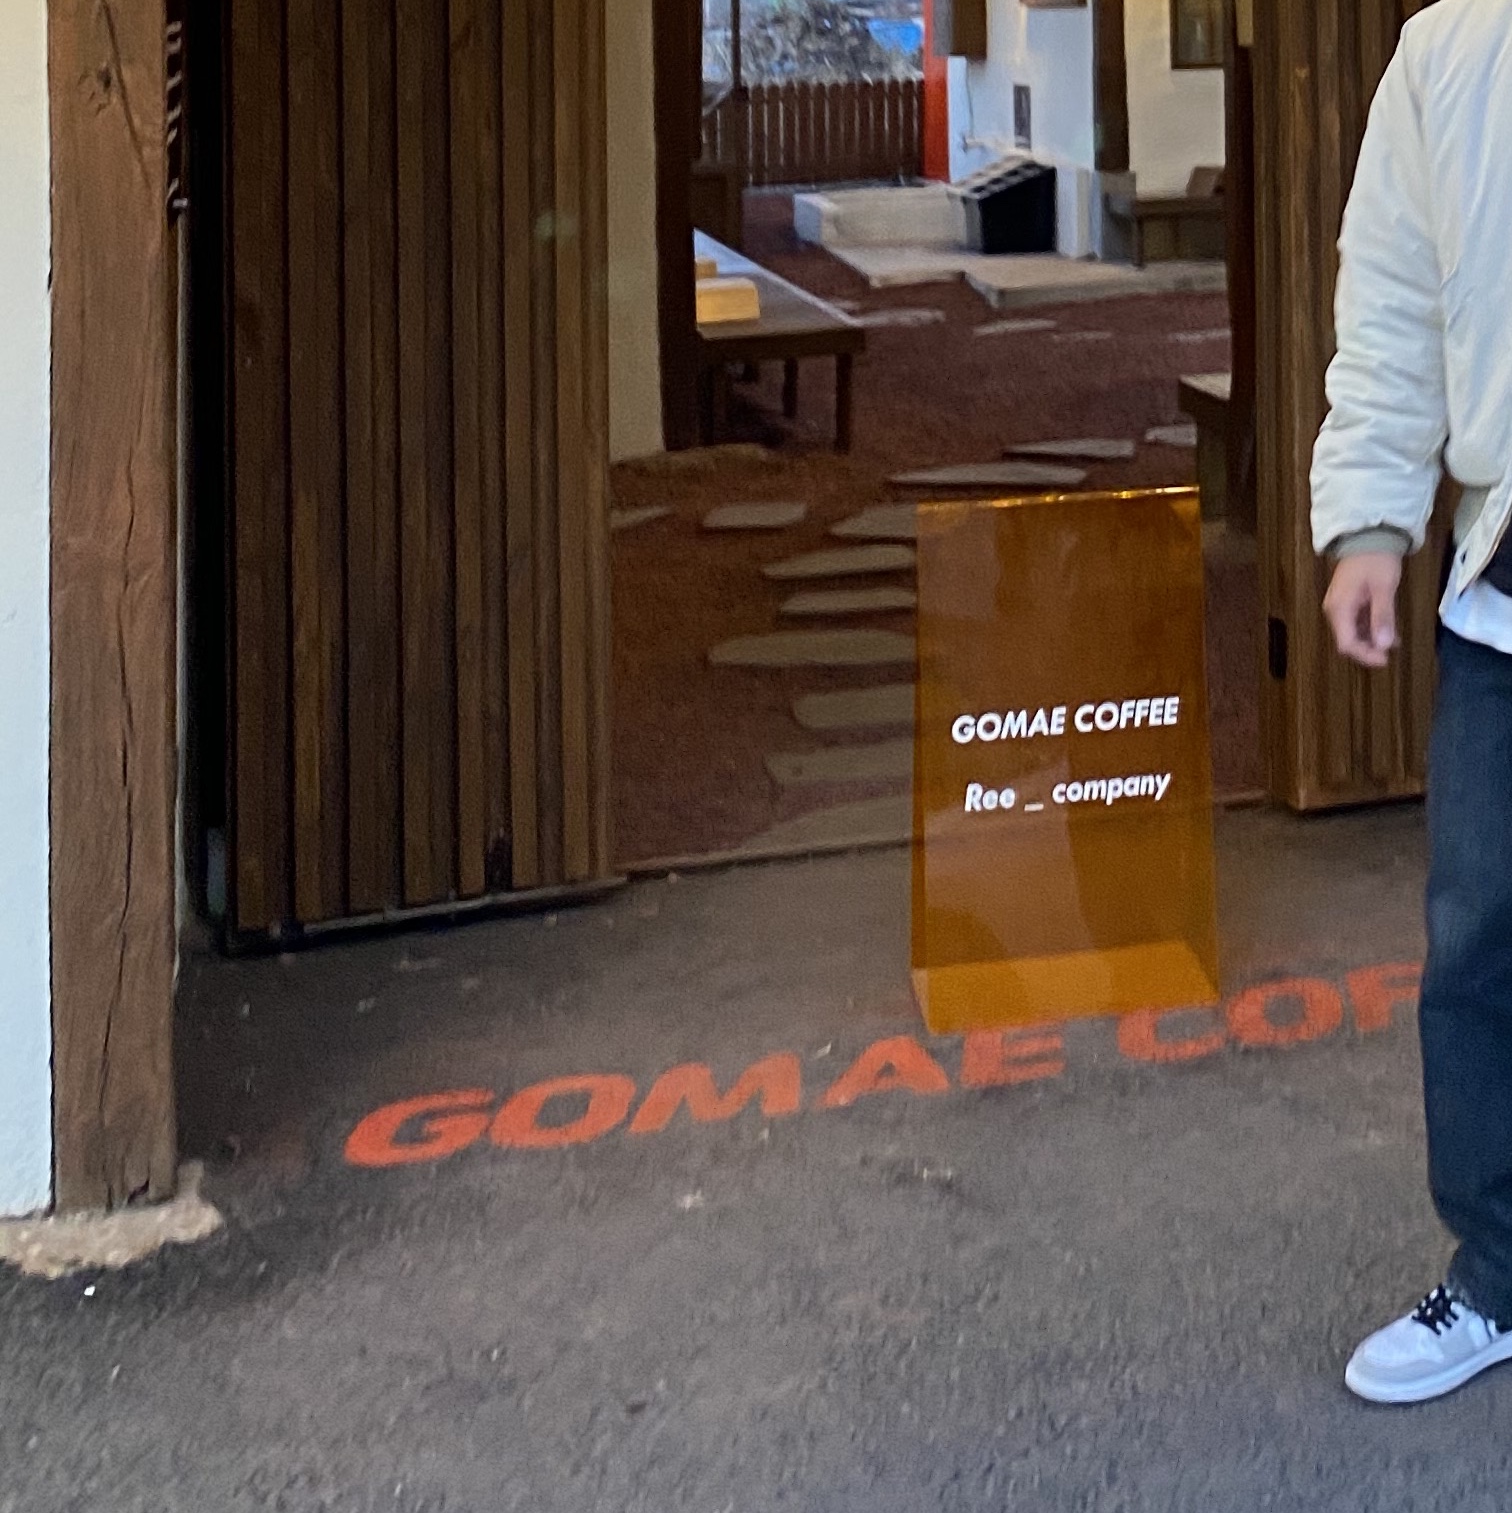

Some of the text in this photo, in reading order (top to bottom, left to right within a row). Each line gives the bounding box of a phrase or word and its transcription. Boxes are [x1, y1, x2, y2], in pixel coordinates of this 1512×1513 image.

[951, 696, 1180, 744] GOMAE COFFEE
[1052, 773, 1171, 806] company
[343, 1026, 1066, 1169] GOMAE
